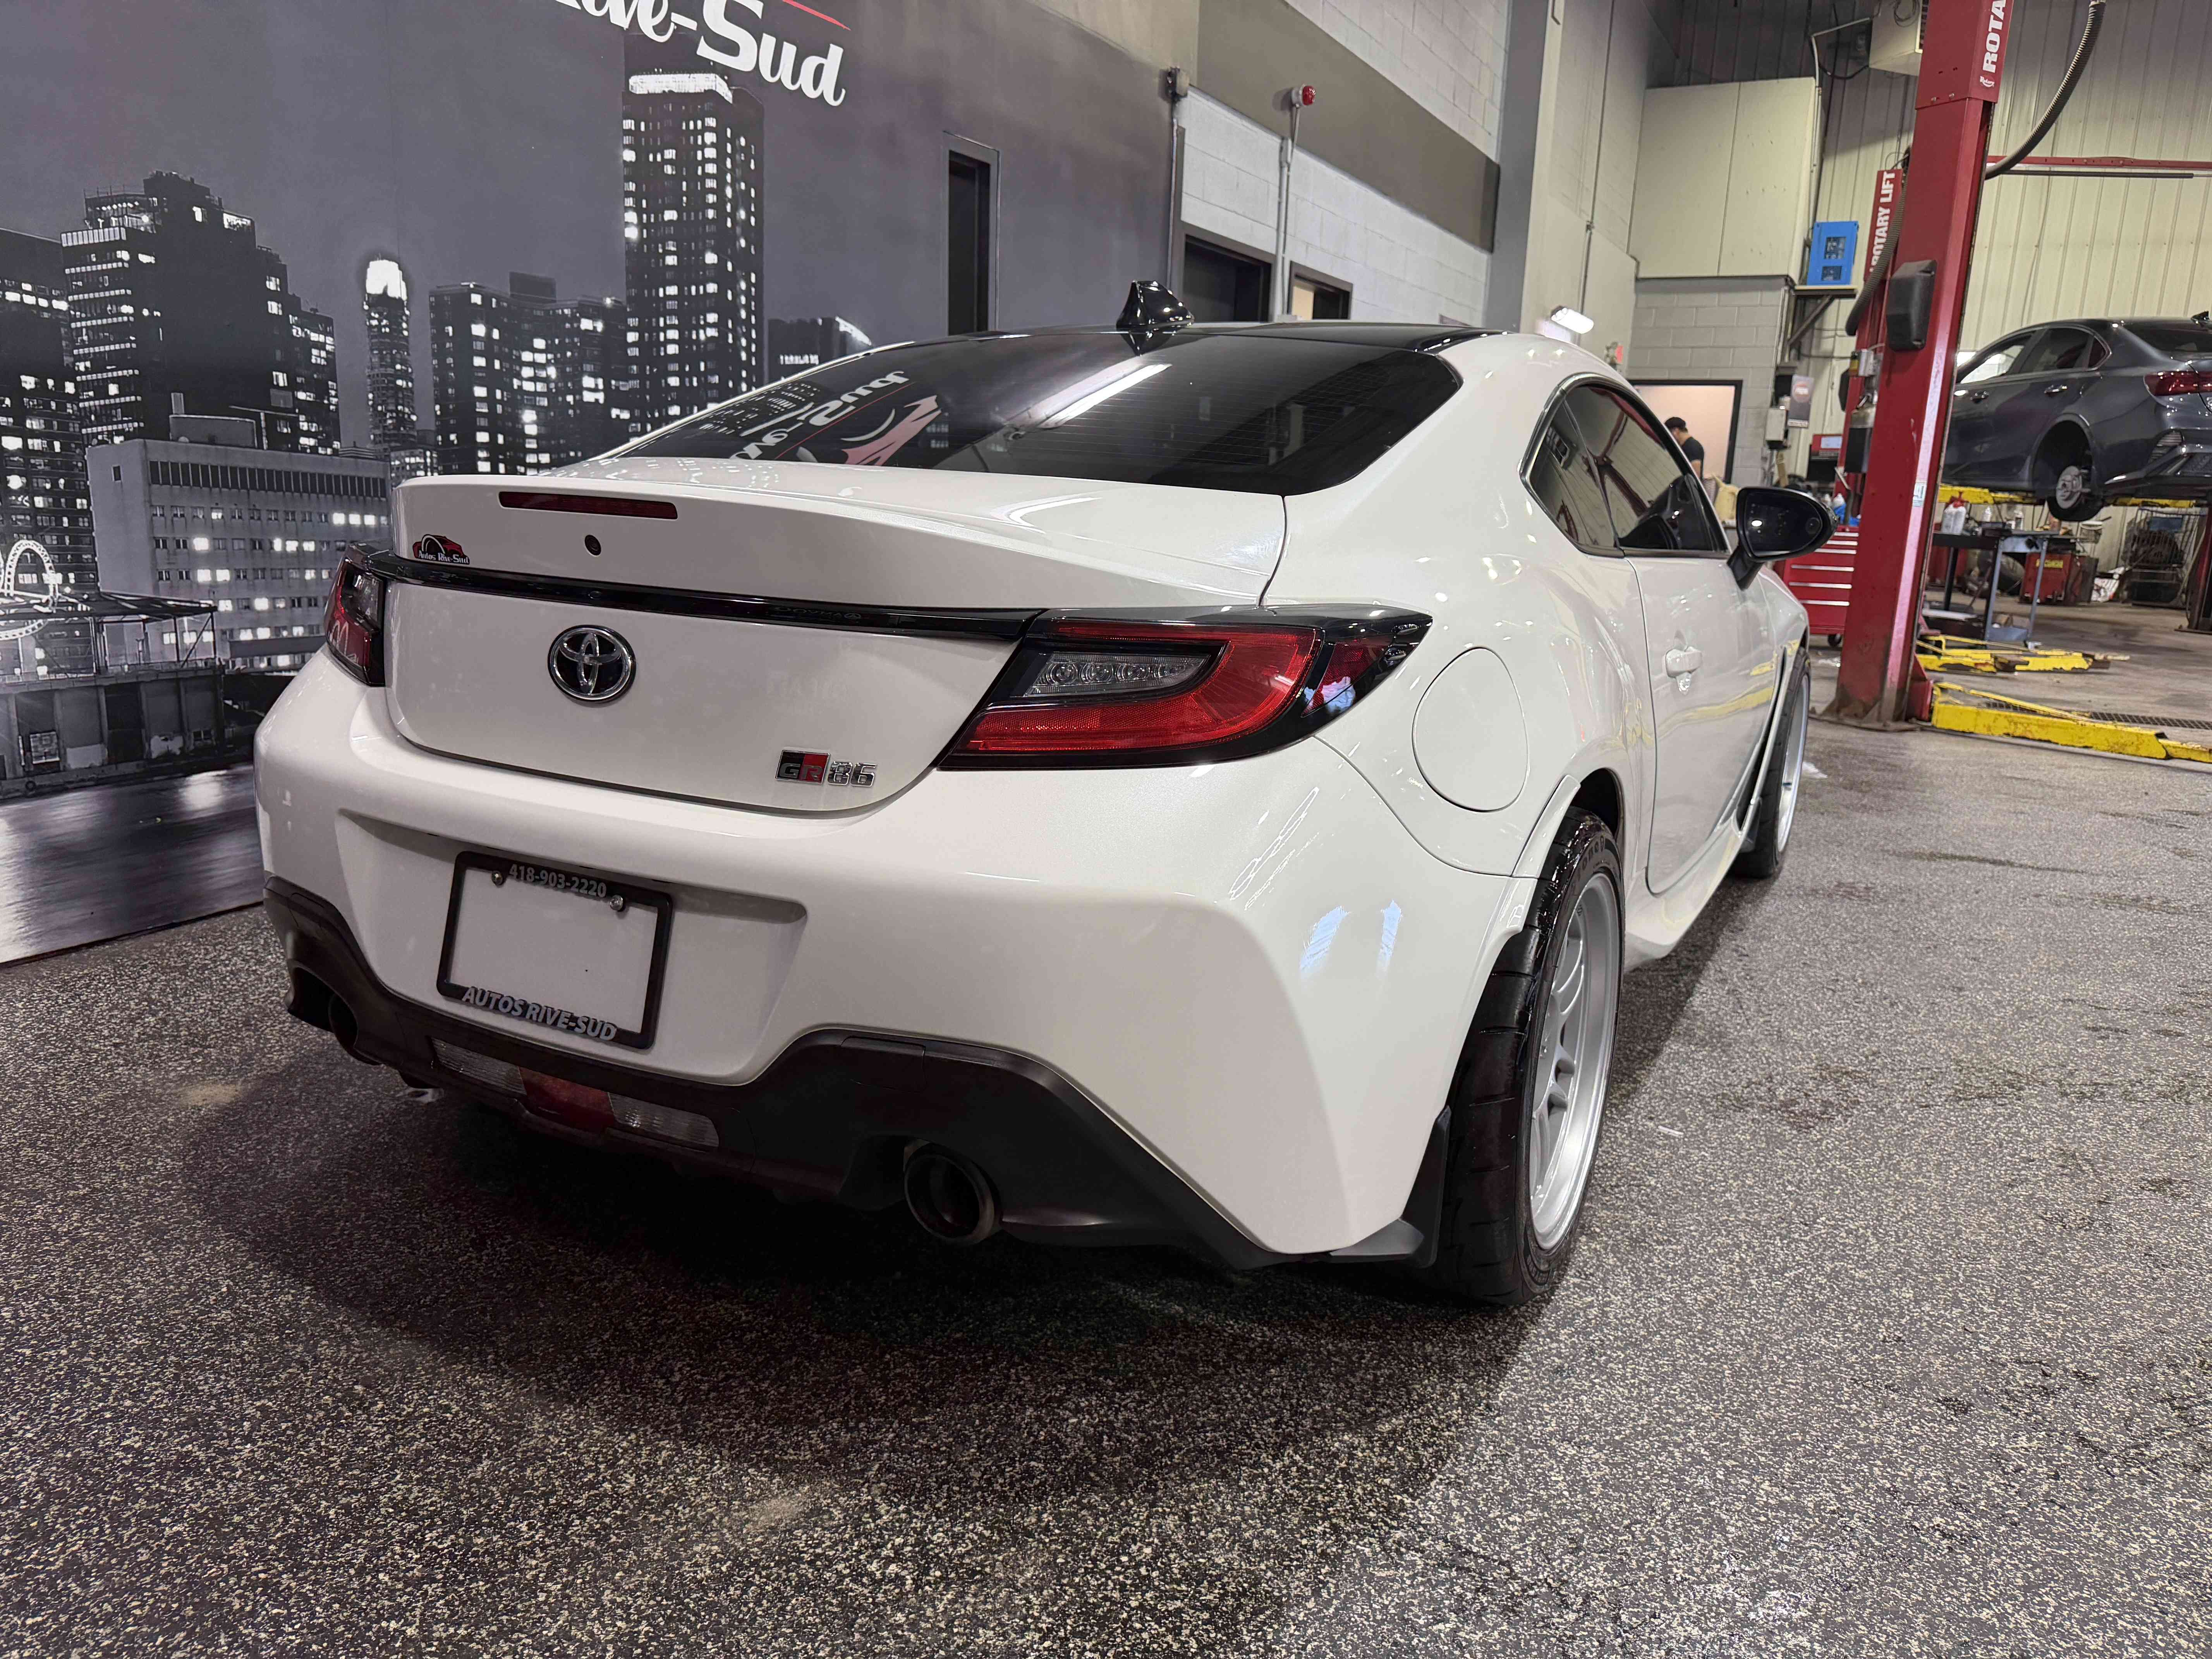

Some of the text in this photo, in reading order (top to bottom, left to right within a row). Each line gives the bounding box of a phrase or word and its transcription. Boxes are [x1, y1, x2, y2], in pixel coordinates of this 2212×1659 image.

[555, 0, 846, 106] ve-Sud
[1880, 171, 1895, 203] LIFT
[419, 550, 436, 560] Autos
[509, 864, 606, 898] 418-903-2220
[462, 986, 618, 1041] AUTOS RIVE-SUD
